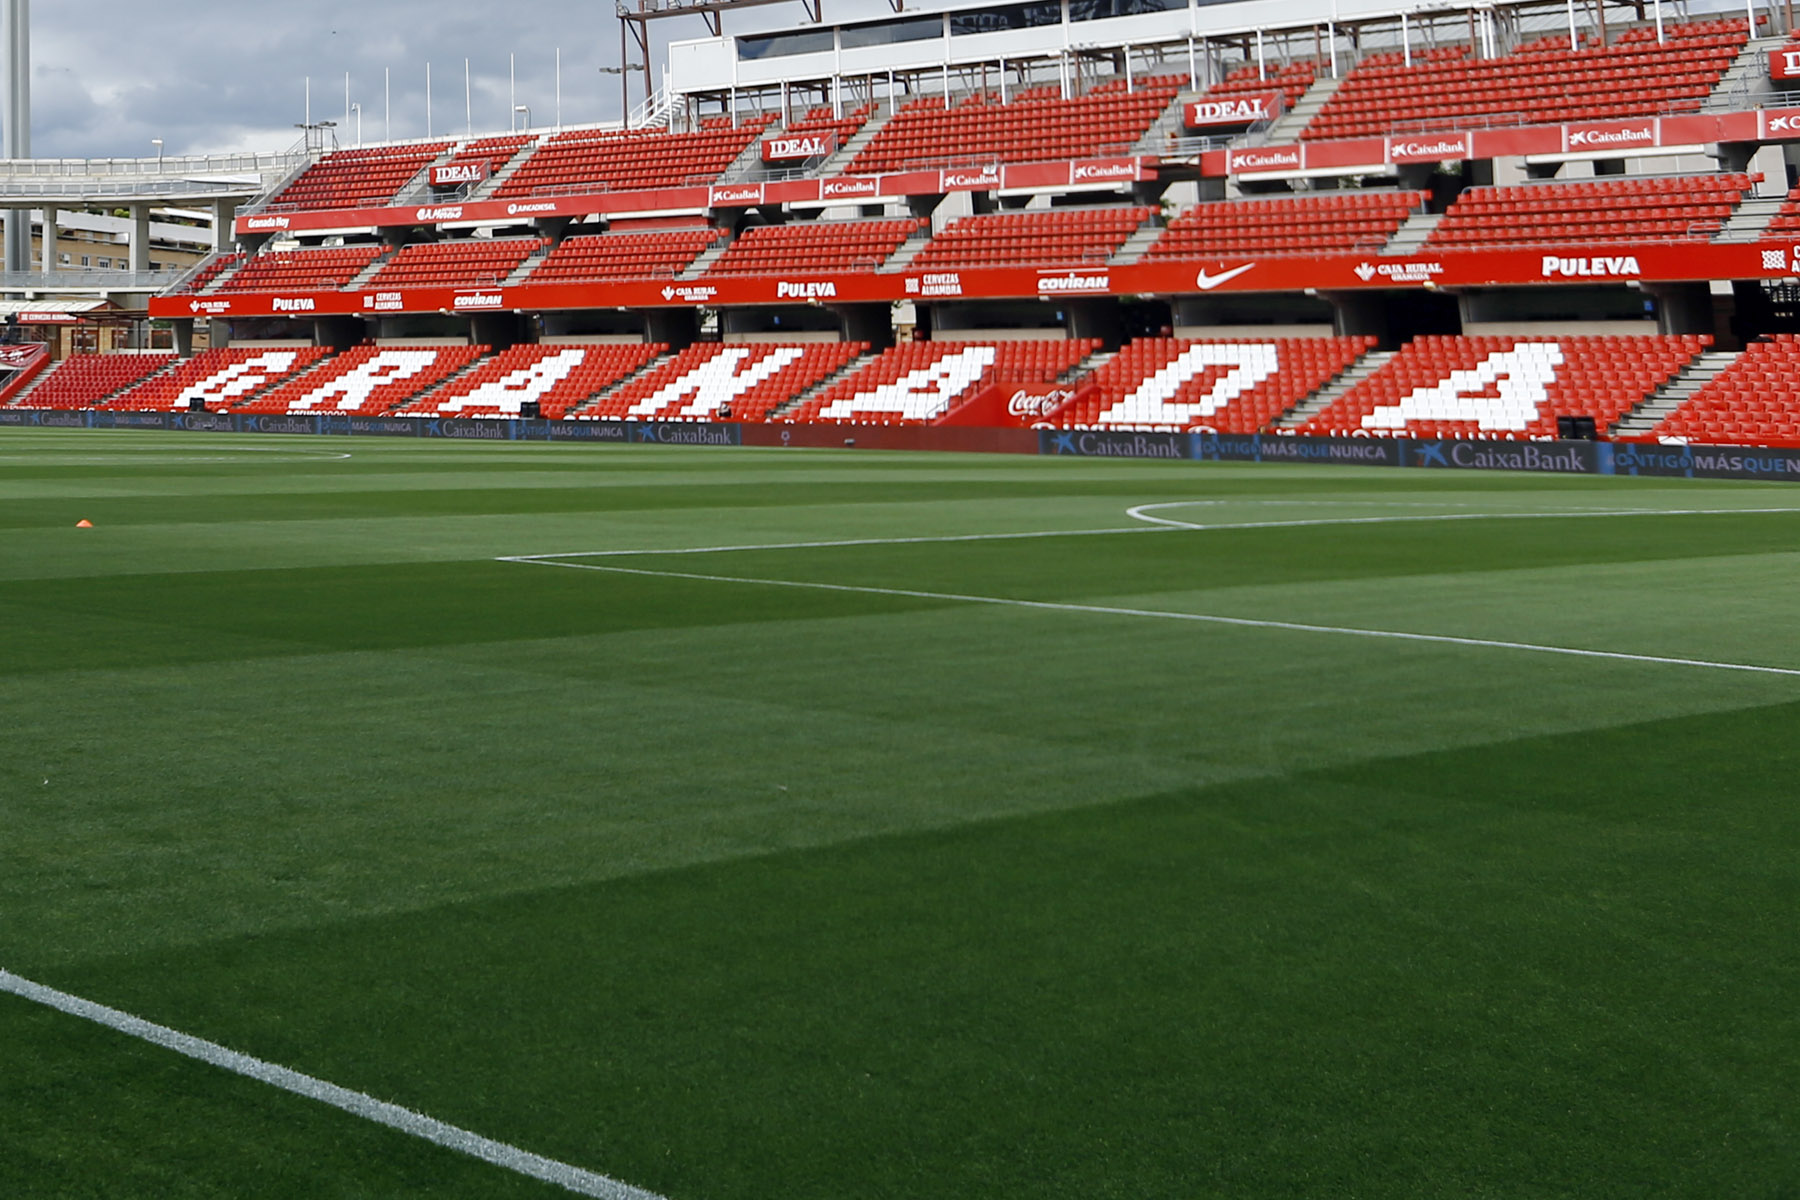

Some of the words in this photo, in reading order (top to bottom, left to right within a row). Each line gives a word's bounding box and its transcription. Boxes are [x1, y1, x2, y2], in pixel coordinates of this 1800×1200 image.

[1587, 128, 1652, 144] CaixaBank
[1407, 141, 1465, 156] CaixaBank
[1247, 151, 1299, 166] CaixaBank
[434, 165, 481, 183] IDEAL
[1087, 164, 1135, 177] CaixaBank
[834, 181, 875, 194] CaixaBank
[956, 175, 999, 187] CaixaBank
[723, 189, 760, 200] CaixaBank
[1377, 265, 1401, 275] CAJA
[1404, 263, 1443, 273] RURAL
[1541, 256, 1640, 276] PULEVA
[922, 273, 959, 284] CERVEZAS
[376, 292, 402, 301] CERVEZAS
[777, 282, 836, 297] PULEVA
[921, 284, 962, 295] ALHAMBRA
[272, 298, 315, 311] PULEVA
[374, 300, 403, 310] ALHAMBRA
[259, 417, 312, 433] CaixaBank
[443, 421, 503, 438] CaixaBank
[658, 424, 732, 444] CaixaBank
[1079, 435, 1181, 458] CaixaBank
[1452, 442, 1585, 471] CaixaBank
